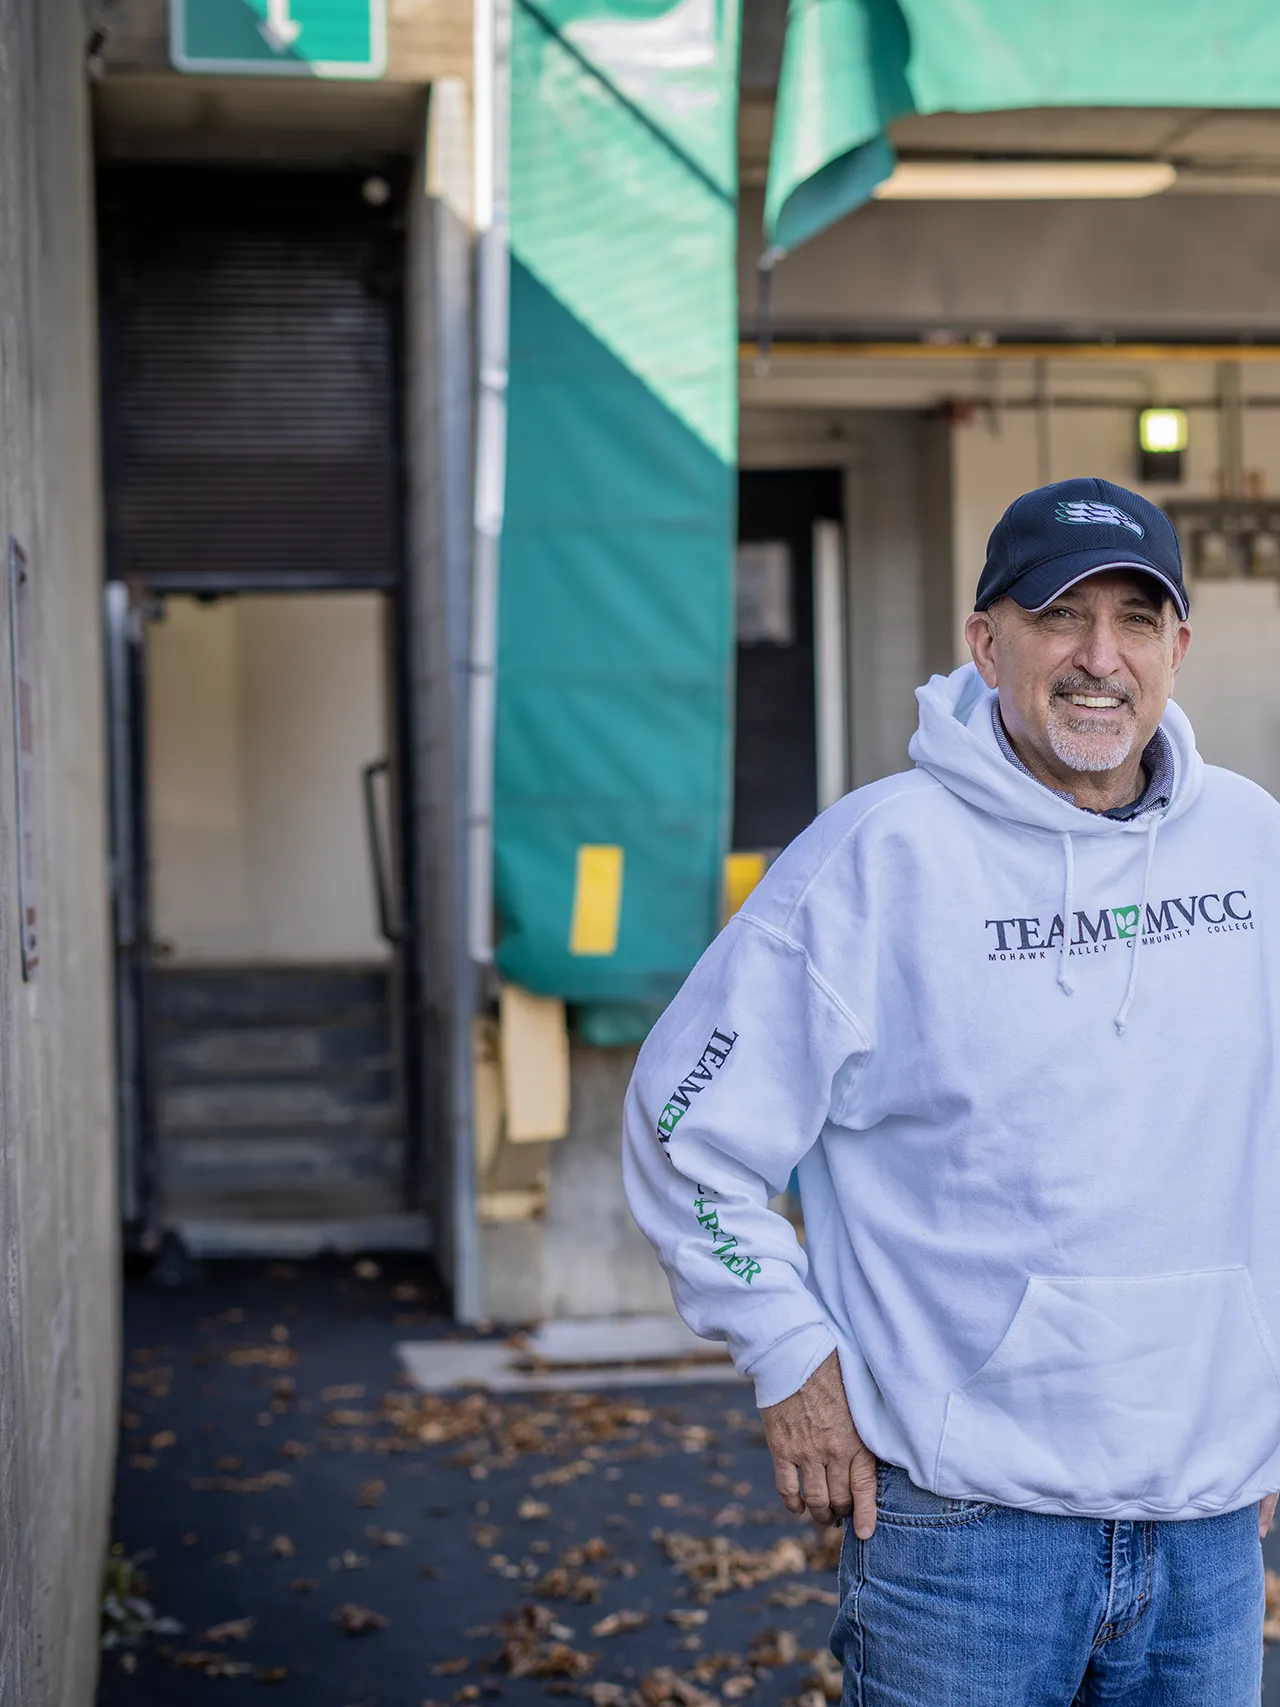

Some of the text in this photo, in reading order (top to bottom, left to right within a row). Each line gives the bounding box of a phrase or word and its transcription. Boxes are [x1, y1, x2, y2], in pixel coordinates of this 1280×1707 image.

[985, 890, 1252, 951] TEAM MVCC
[988, 921, 1255, 961] MOHAWK ALLEY CMMUNITY COLLEGE
[669, 1027, 740, 1111] TEAM
